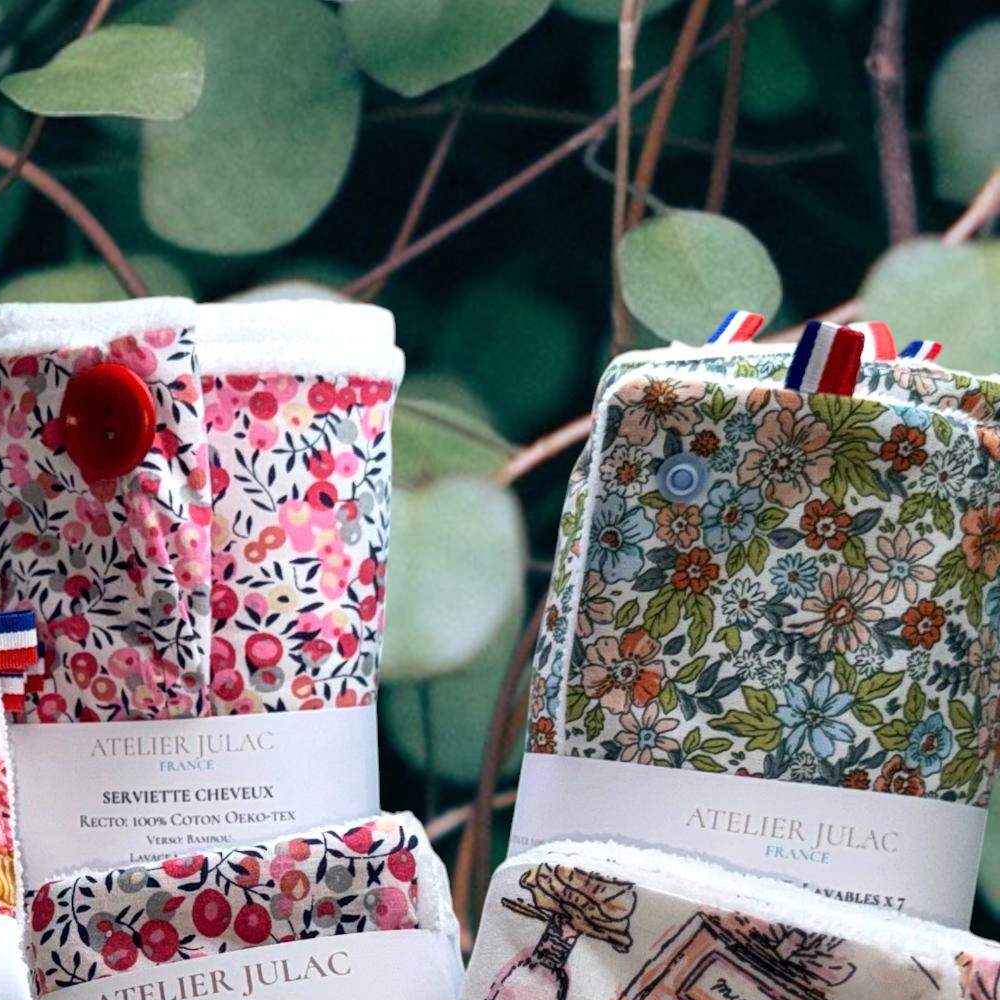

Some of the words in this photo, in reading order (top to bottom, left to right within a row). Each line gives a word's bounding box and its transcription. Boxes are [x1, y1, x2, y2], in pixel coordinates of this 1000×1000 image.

[90, 735, 194, 757] ATELIER
[199, 731, 274, 759] JULAC
[160, 759, 214, 772] FRANCE
[103, 788, 191, 805] SERVIETTE
[195, 785, 274, 802] CHEVEUX
[133, 814, 167, 827] 100%
[170, 813, 221, 826] COTON
[685, 808, 805, 841] ATELIER
[812, 823, 899, 853] JULAC
[765, 846, 830, 864] FRANCE
[242, 951, 351, 997] JULAC
